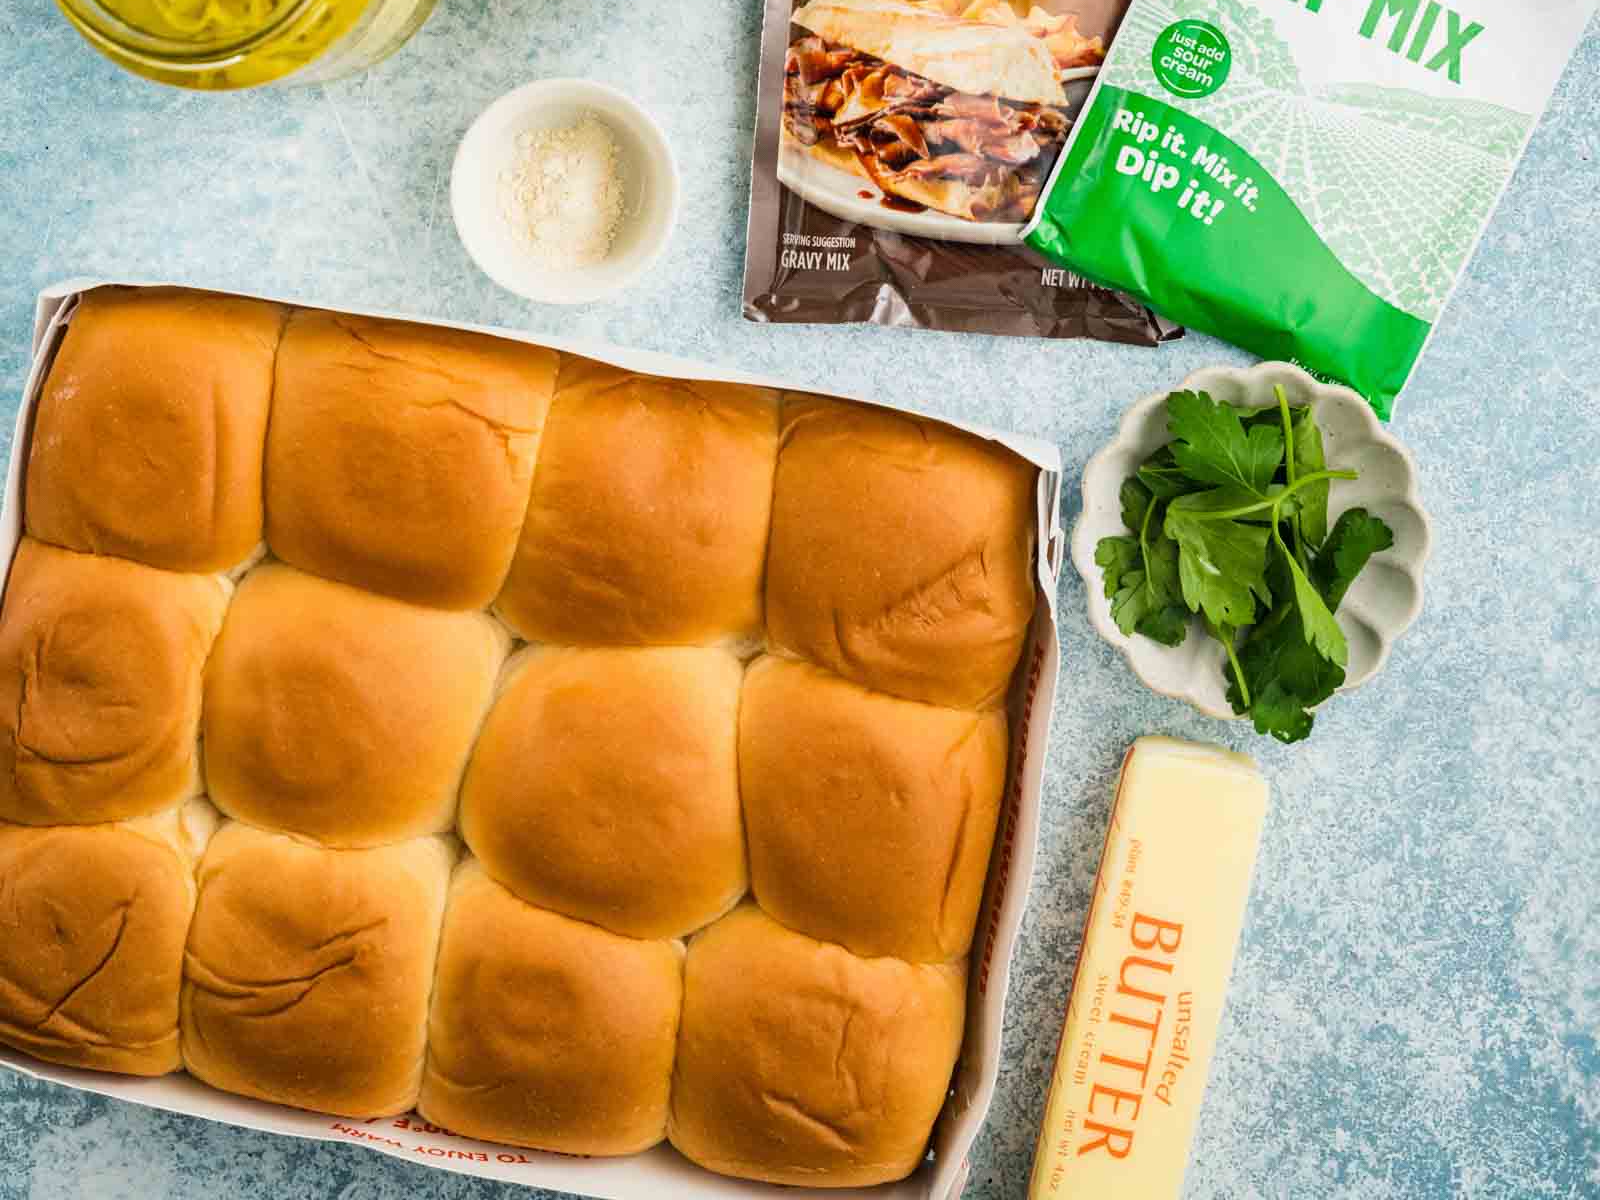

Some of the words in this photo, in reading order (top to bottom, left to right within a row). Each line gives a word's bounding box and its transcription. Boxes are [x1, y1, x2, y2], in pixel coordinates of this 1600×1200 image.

[1169, 29, 1198, 51] just
[1197, 41, 1225, 62] add
[1172, 47, 1213, 71] sour
[1160, 55, 1213, 88] cream
[1113, 108, 1159, 144] Rip
[1161, 125, 1187, 159] it.
[1191, 145, 1238, 189] Mix
[1233, 177, 1259, 212] it.
[1116, 145, 1180, 193] Dip
[1177, 179, 1225, 225] it!
[783, 233, 811, 247] SERVING
[812, 236, 856, 248] SUGGESTION
[781, 249, 823, 270] GRAVY
[826, 252, 851, 271] MIX
[1041, 268, 1065, 287] NET
[1076, 911, 1184, 1159] BUTTER
[1154, 990, 1194, 1107] unsalted
[1072, 1030, 1098, 1086] cream
[330, 1122, 403, 1148] WARM
[416, 1145, 489, 1163] ENJOY
[496, 1152, 534, 1164] TO
